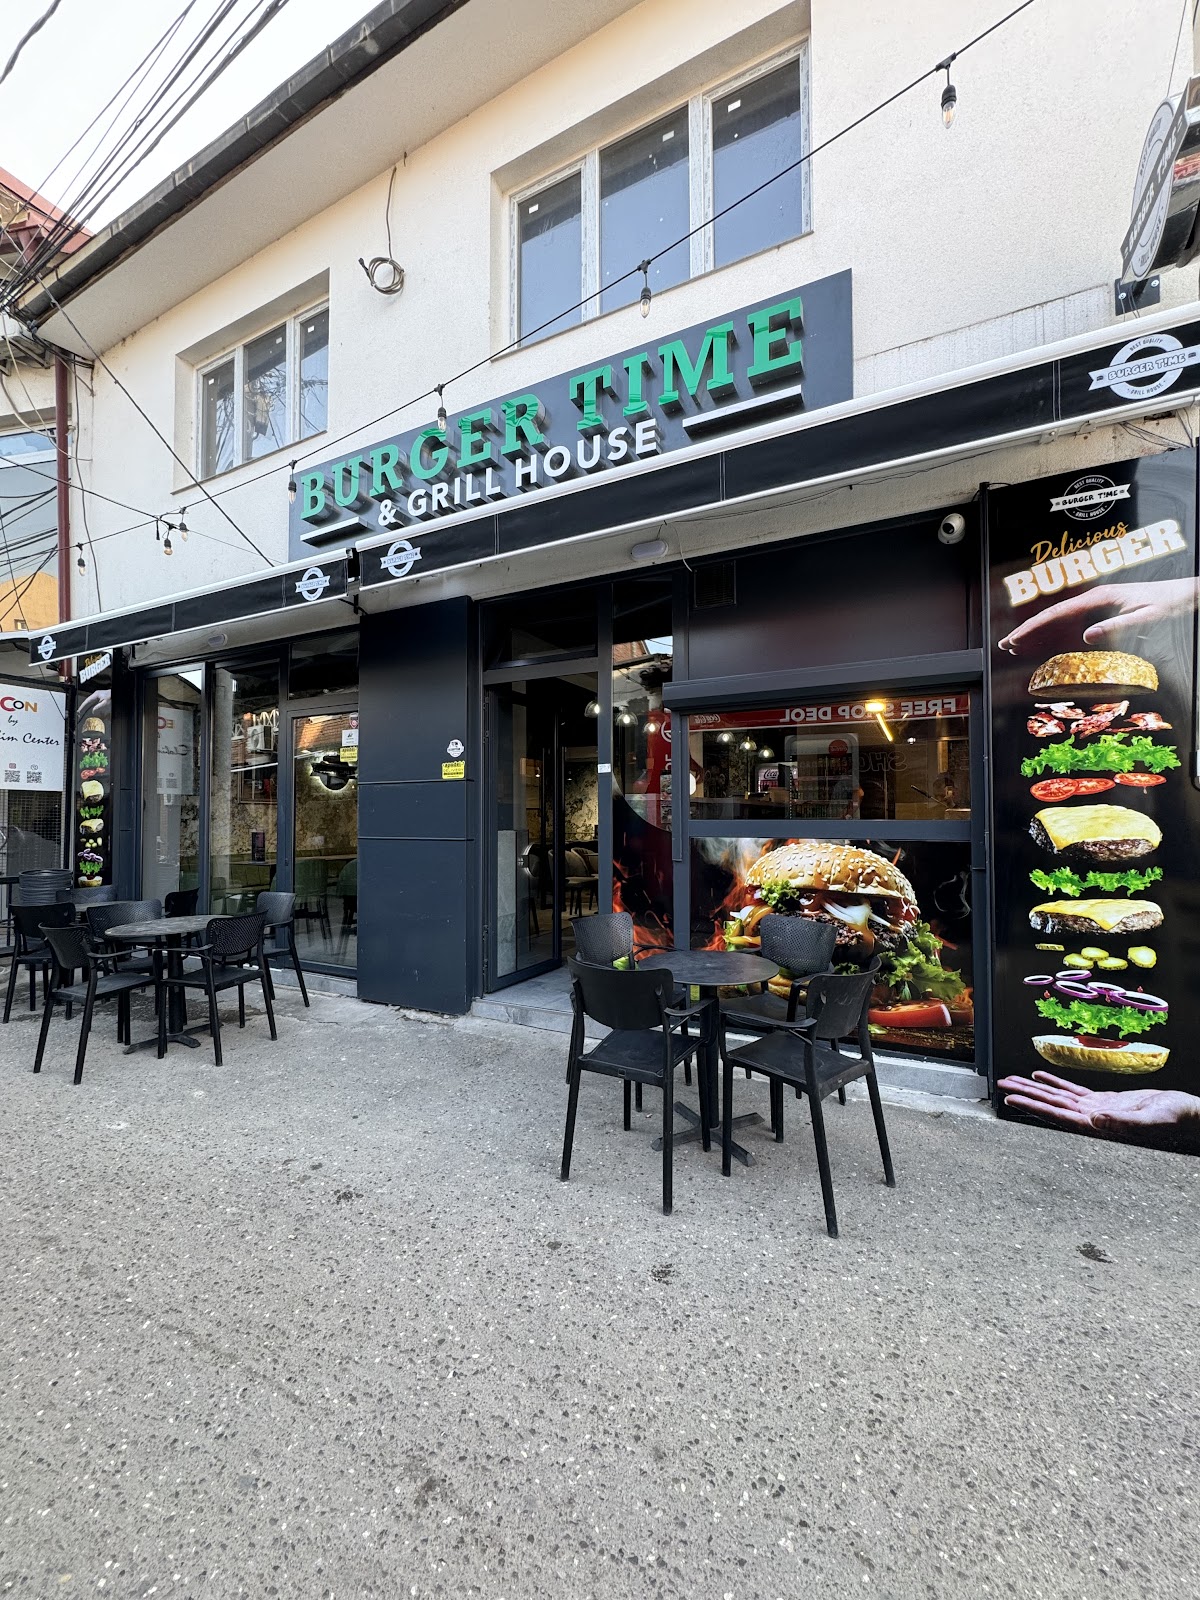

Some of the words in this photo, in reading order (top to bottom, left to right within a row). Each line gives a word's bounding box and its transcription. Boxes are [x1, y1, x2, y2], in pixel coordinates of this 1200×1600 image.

[1129, 342, 1142, 352] BEST
[1107, 362, 1154, 381] BURGER
[1146, 382, 1164, 394] HOUSE
[300, 393, 545, 521] BURGER
[569, 296, 803, 433] TIME
[377, 499, 398, 527] &
[406, 469, 501, 519] GRILL
[515, 418, 658, 489] HOUSE
[1073, 480, 1085, 489] BEST
[1062, 494, 1094, 506] BURGER
[1089, 507, 1106, 517] HOUSE
[1030, 520, 1129, 566] Delicious
[1003, 519, 1187, 606] BURGER
[8, 715, 18, 726] by
[0, 730, 18, 741] im
[22, 732, 60, 745] Center
